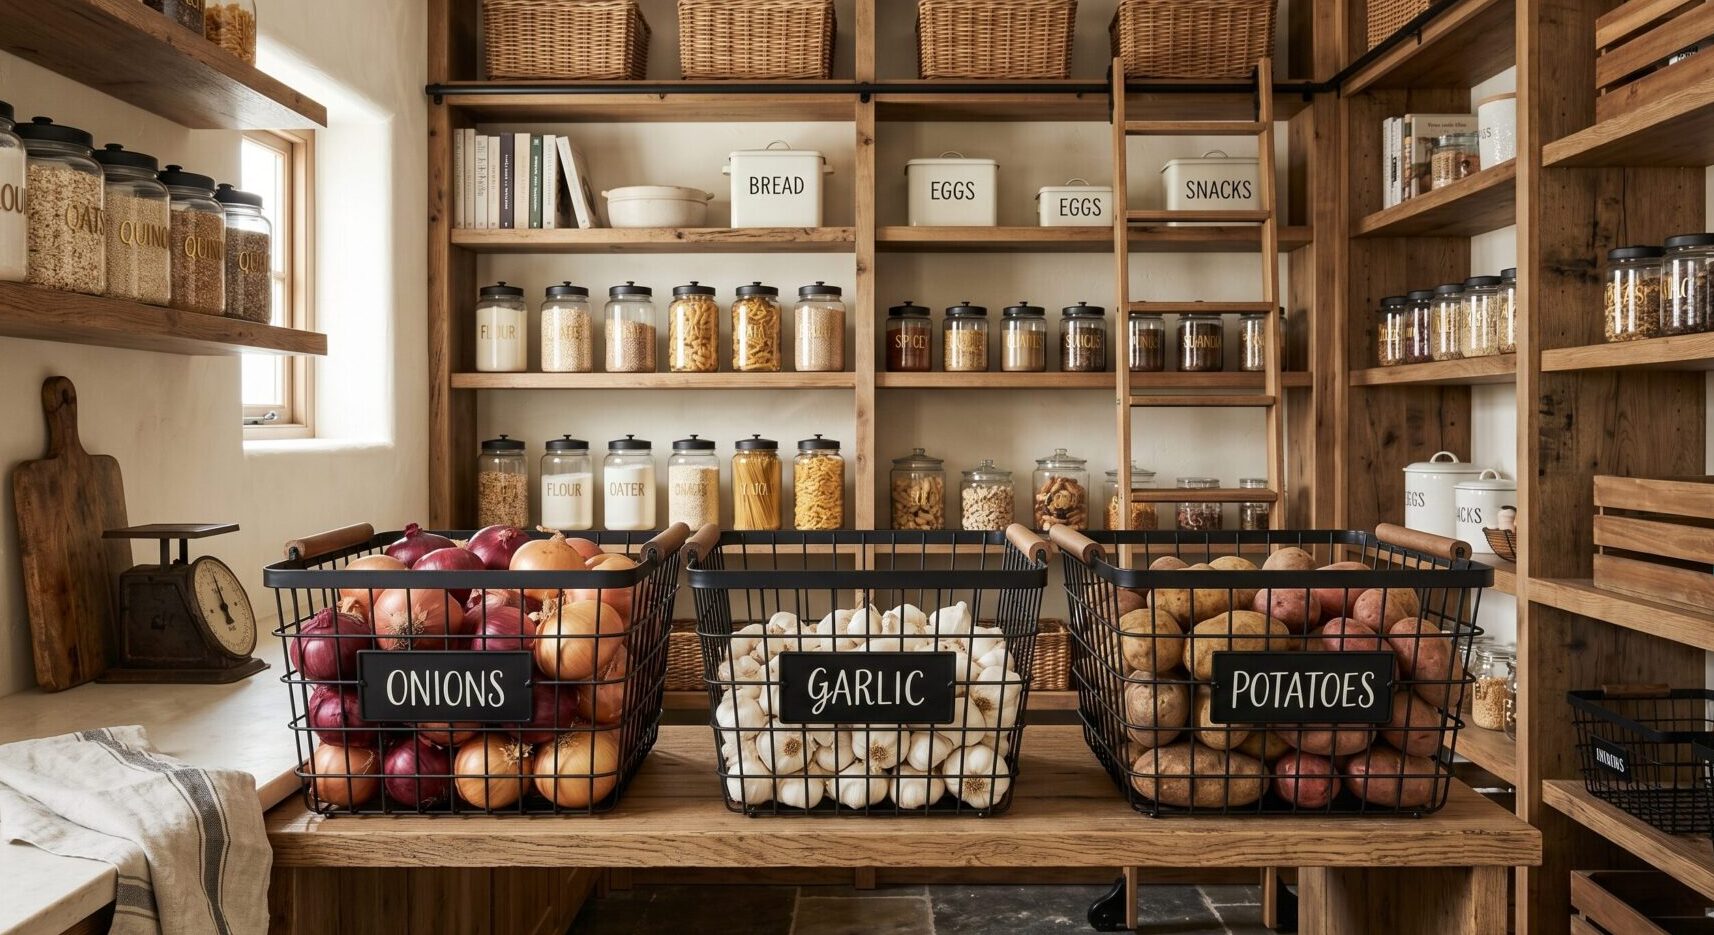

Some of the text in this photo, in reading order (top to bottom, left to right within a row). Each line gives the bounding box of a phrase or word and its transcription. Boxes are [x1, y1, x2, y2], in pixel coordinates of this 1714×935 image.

[749, 176, 805, 195] BREAD
[931, 181, 975, 200] EGGS
[1185, 179, 1252, 199] SNACKS
[1059, 197, 1102, 217] EGGS
[547, 482, 582, 497] FLOUR
[609, 482, 645, 497] OATER
[386, 669, 505, 708] ONIONS
[807, 667, 925, 715] GARLIC
[1232, 670, 1375, 709] POTATOES
